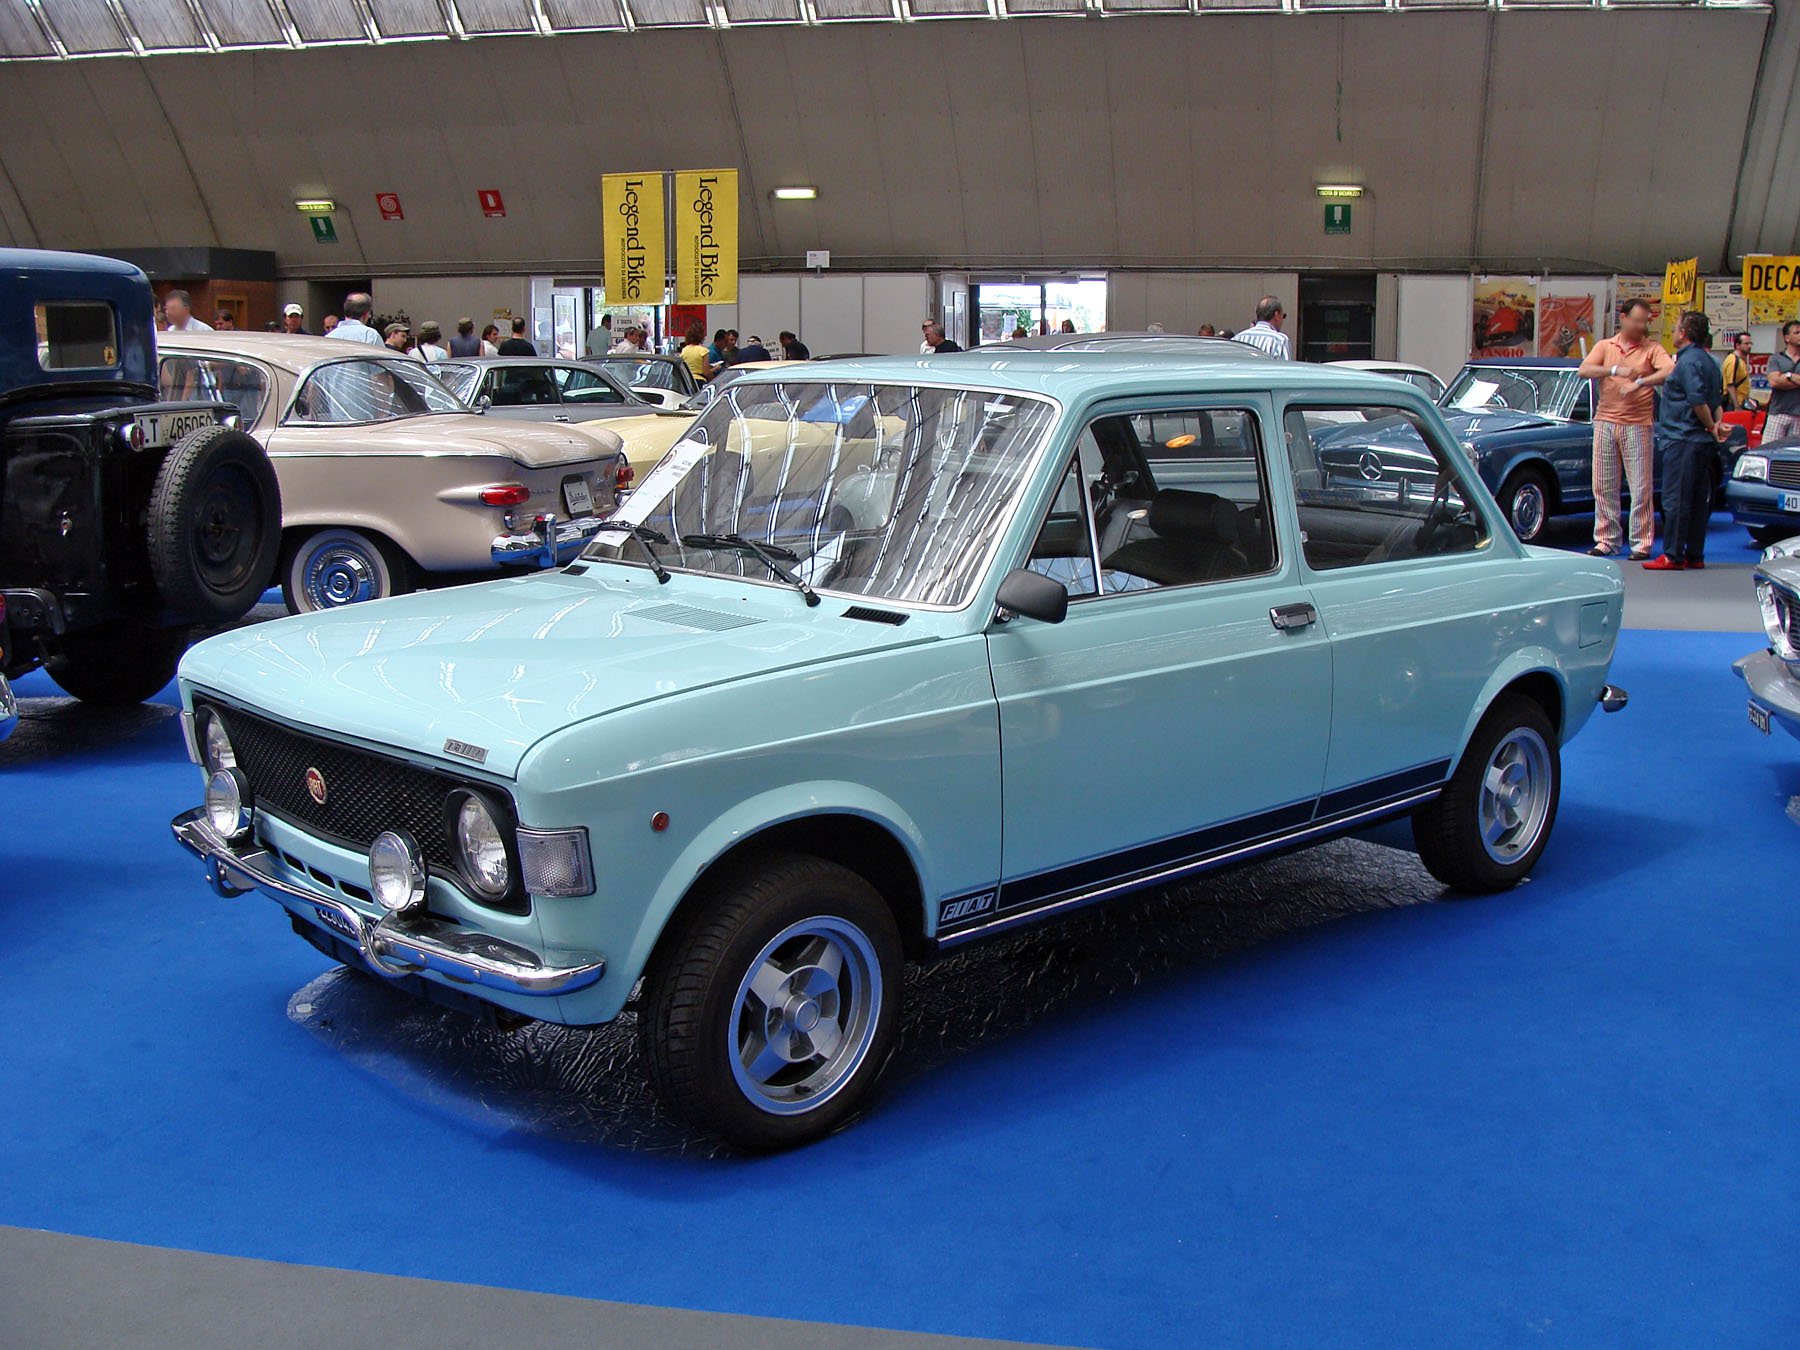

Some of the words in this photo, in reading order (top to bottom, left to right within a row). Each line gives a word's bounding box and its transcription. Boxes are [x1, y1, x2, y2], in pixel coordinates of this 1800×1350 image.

[620, 180, 646, 252] Legend
[693, 176, 720, 249] Legend
[627, 255, 647, 299] Bike
[700, 252, 720, 298] Bike
[940, 892, 994, 922] FIAT
